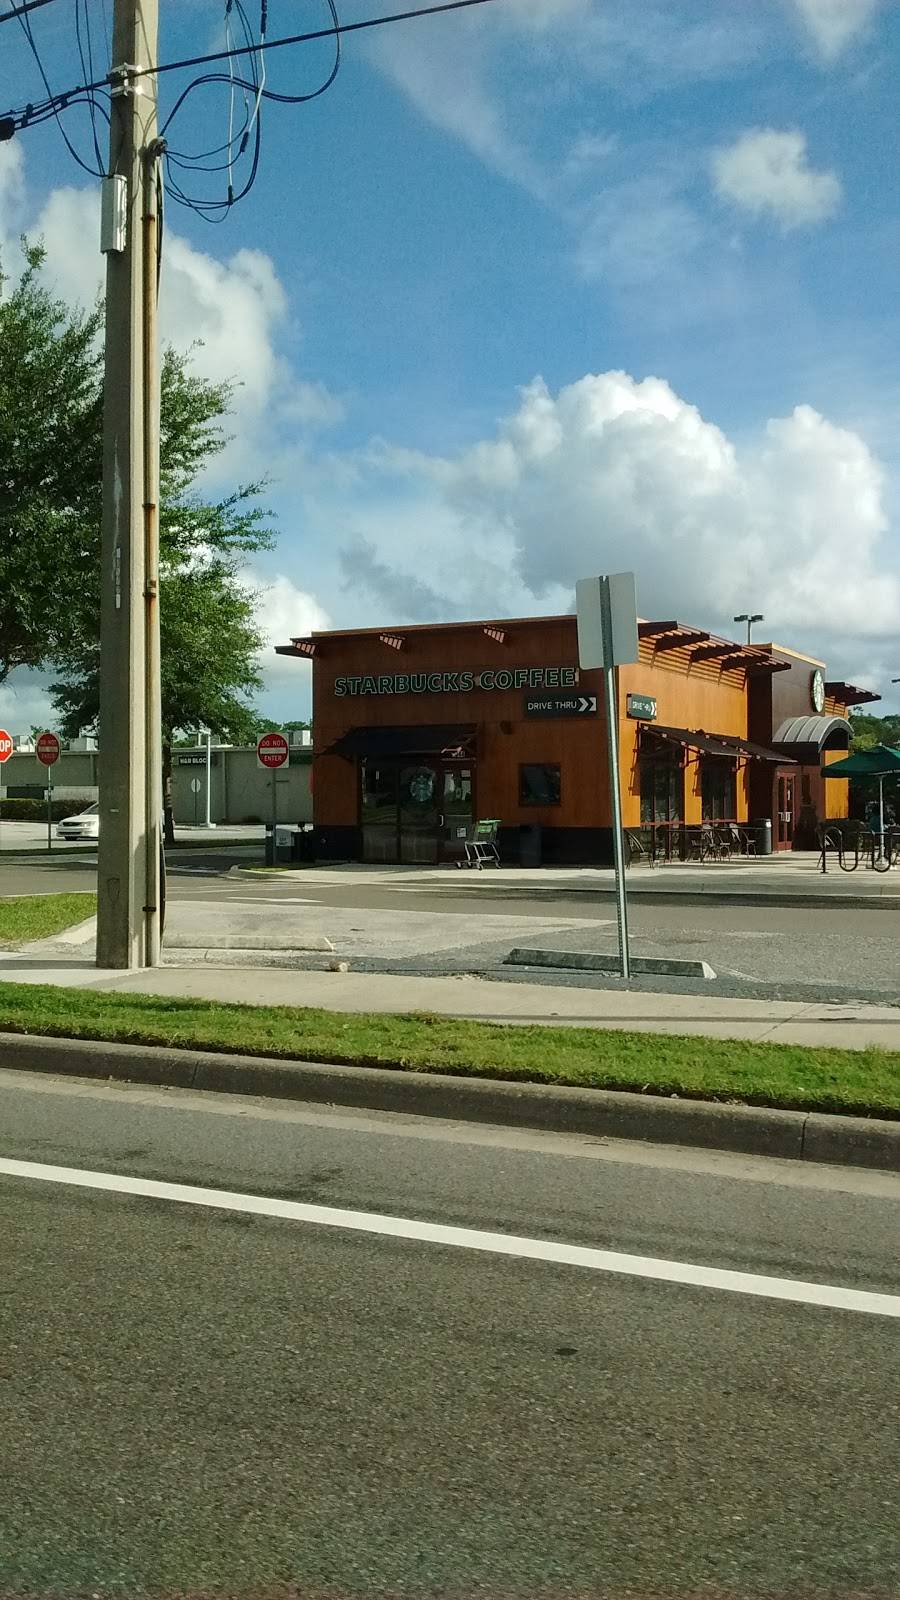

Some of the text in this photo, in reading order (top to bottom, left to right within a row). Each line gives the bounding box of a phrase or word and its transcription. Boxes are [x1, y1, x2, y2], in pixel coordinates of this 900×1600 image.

[334, 667, 575, 697] STARBUCKS COFFEE
[527, 700, 577, 711] DRIVE THRU
[0, 739, 11, 753] OP
